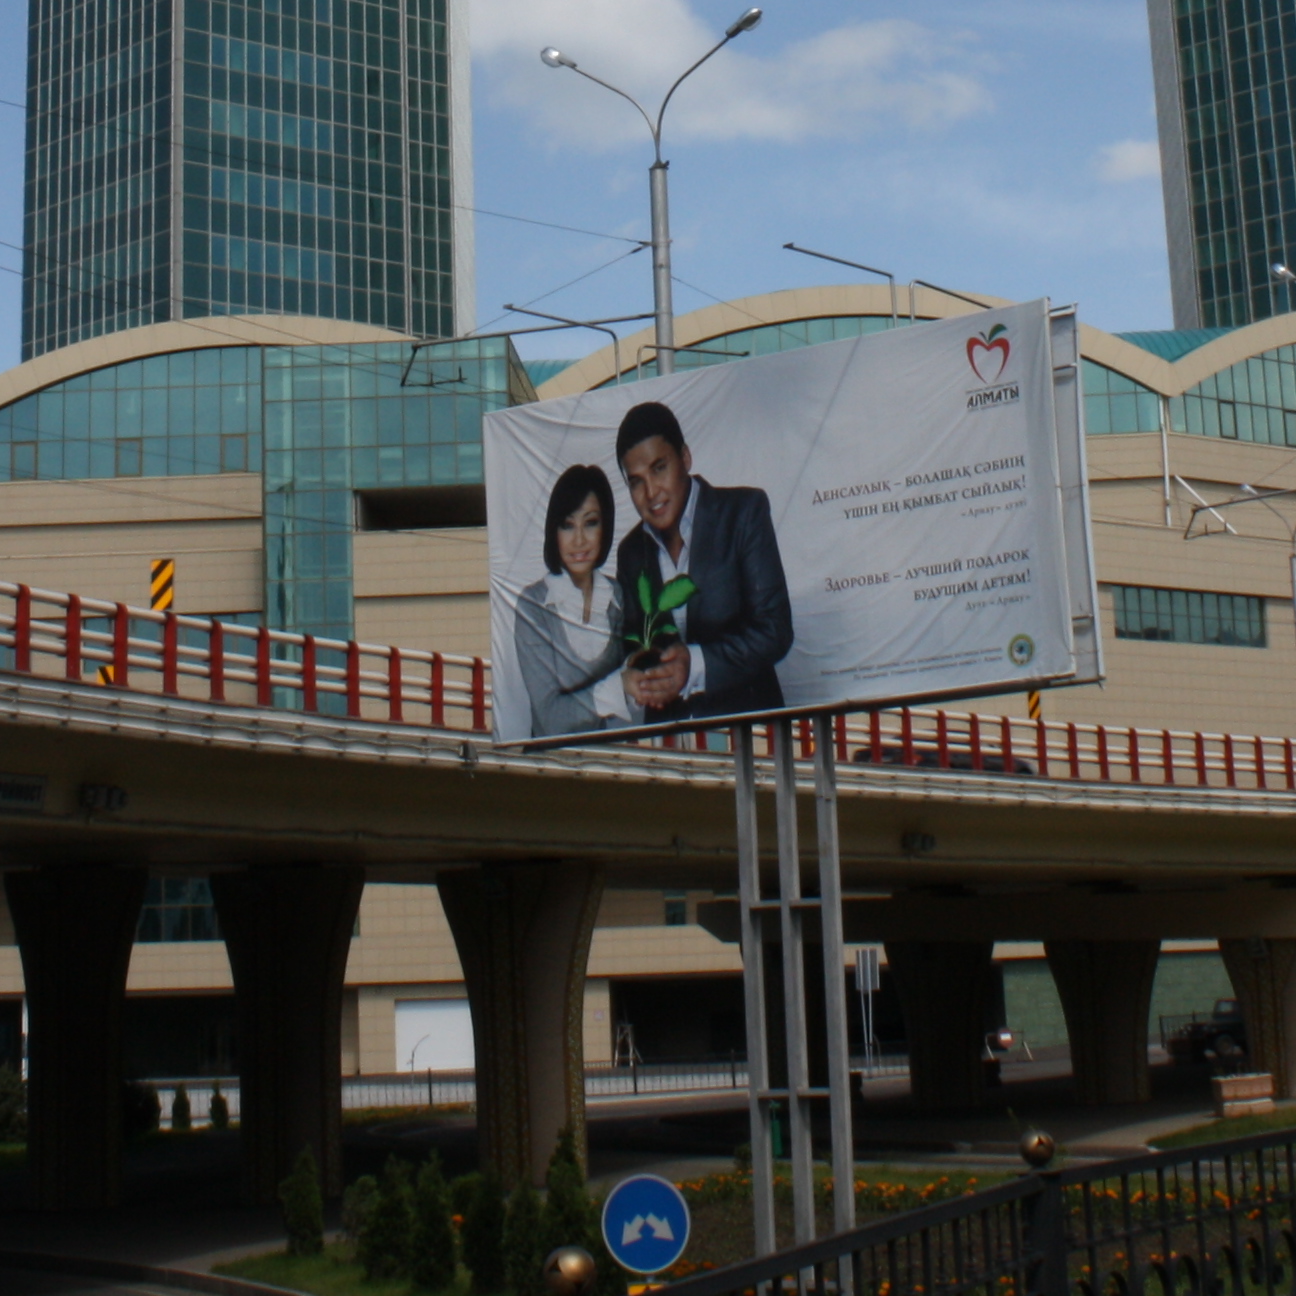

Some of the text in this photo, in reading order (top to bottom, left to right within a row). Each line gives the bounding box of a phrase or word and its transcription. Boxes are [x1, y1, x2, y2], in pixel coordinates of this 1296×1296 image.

[967, 385, 1019, 408] АЛМАТЫ
[905, 463, 972, 488] БОЛАШАҚ
[903, 491, 958, 510] ҚЫМБАТ
[961, 475, 1026, 500] СЫЙЛЫҚ!
[905, 558, 962, 581] ЛУЧШИЙ
[966, 549, 1030, 570] ПОДАРОК
[914, 569, 1031, 602] БУДУЩИМ ДЕТЯМ!
